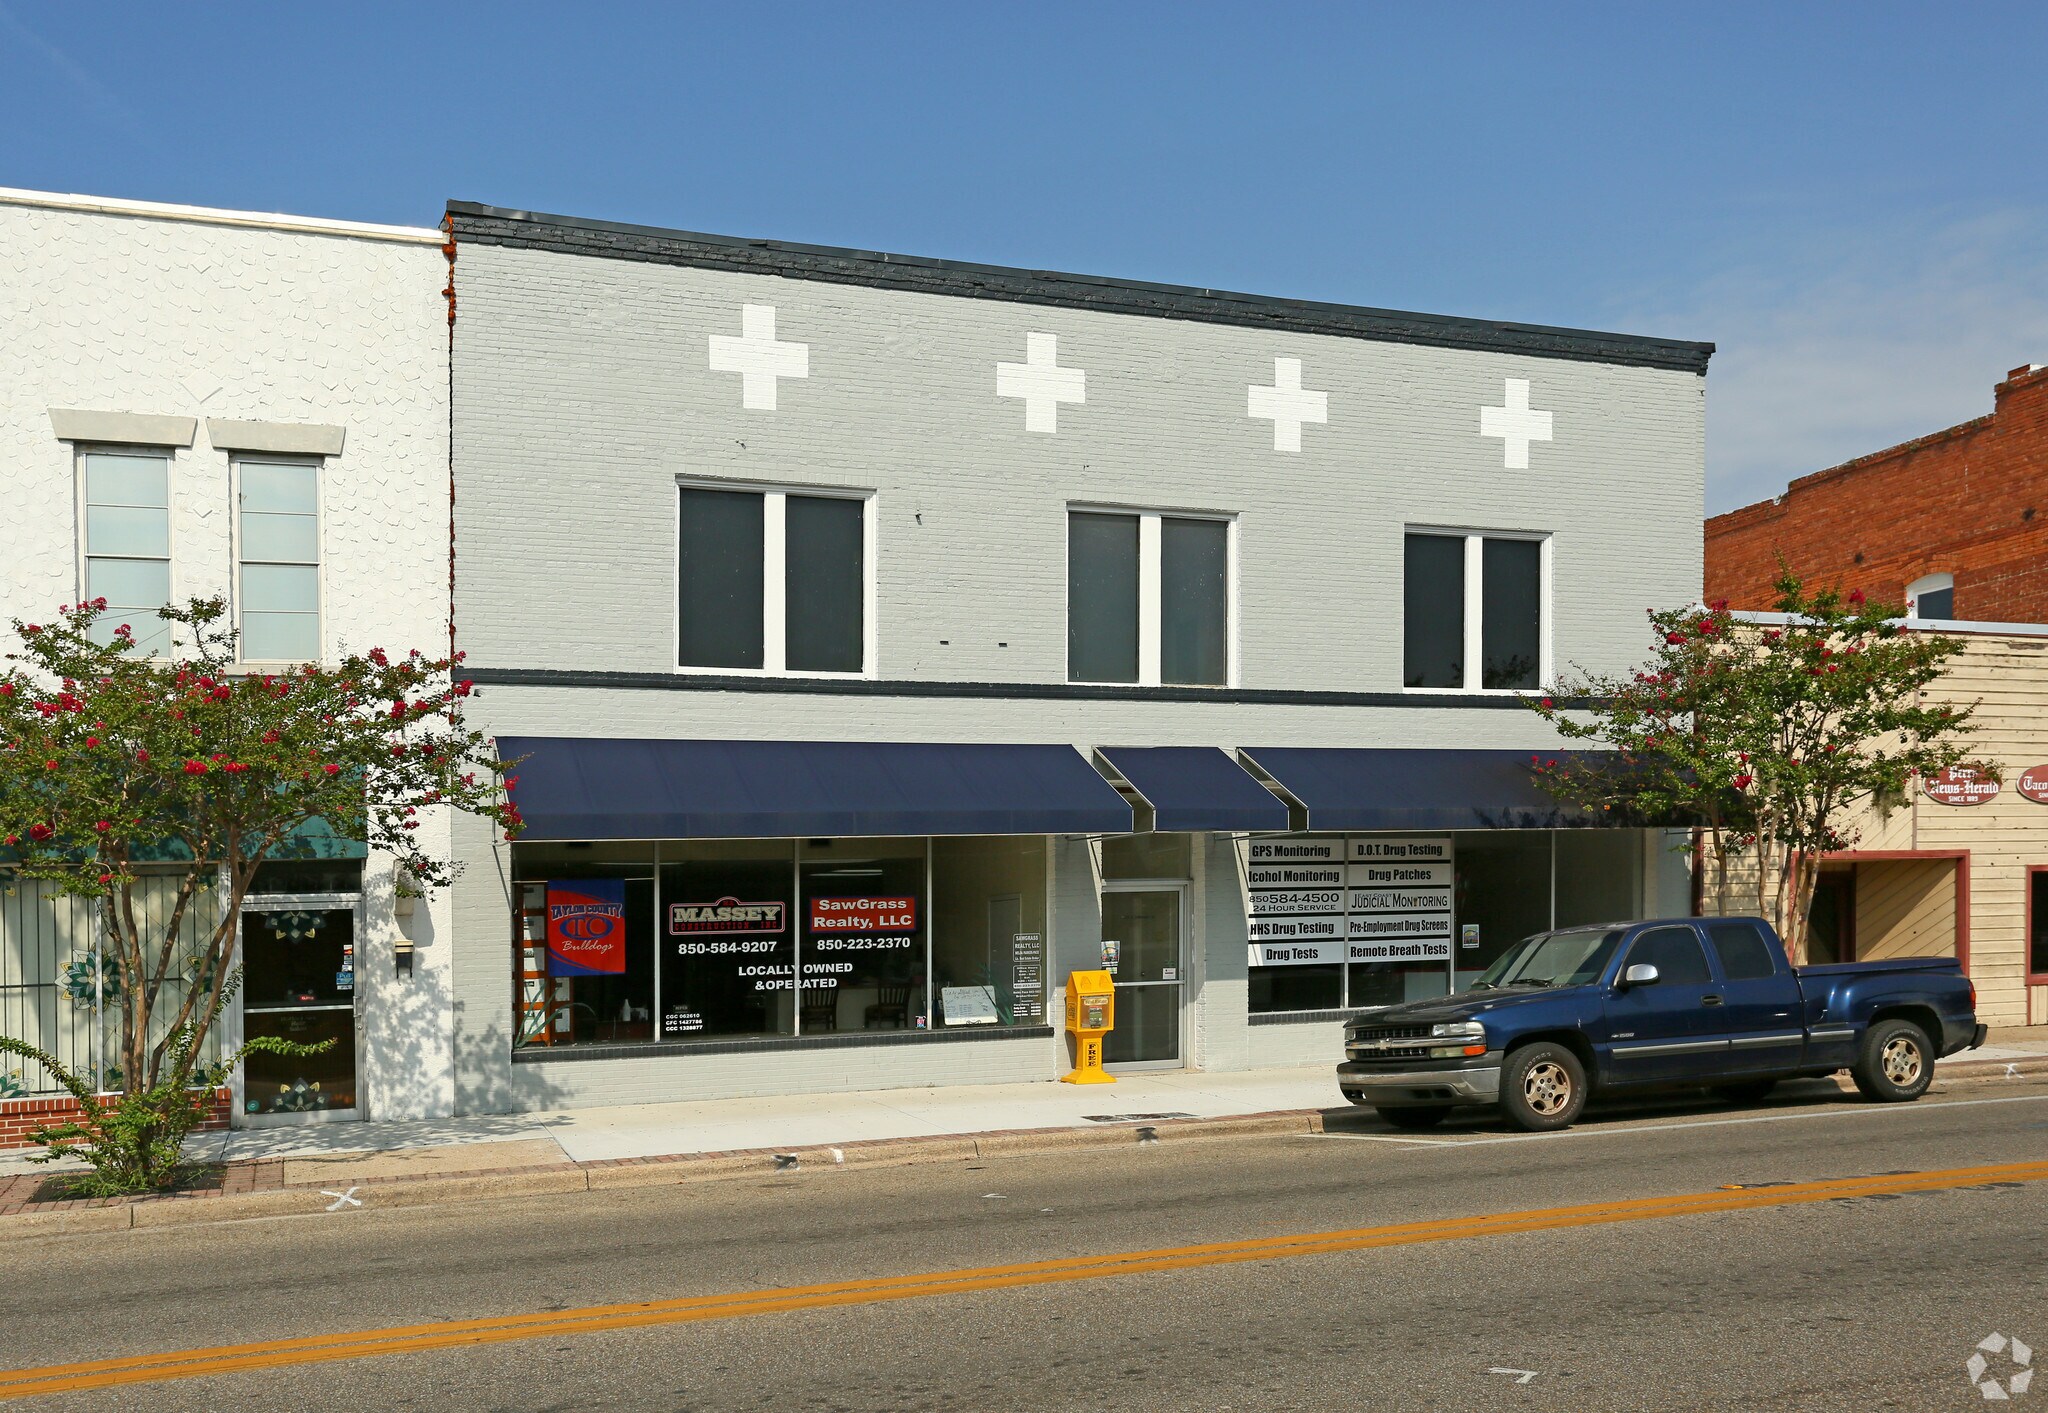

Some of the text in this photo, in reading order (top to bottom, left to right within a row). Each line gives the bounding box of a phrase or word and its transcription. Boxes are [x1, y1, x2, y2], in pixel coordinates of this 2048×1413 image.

[2023, 776, 2048, 790] Taco
[1252, 845, 1331, 857] GPS Monitoring
[1357, 844, 1443, 857] D.O.T. Drug Testing
[1249, 870, 1340, 882] lcohol Monitoring
[1368, 869, 1432, 881] Drug Patches
[818, 899, 907, 910] SawGrass
[1351, 894, 1390, 908] JUDICIAL
[551, 903, 622, 921] TAYLOR COUNTY
[674, 906, 780, 922] MASSEY
[813, 914, 912, 929] Realty, LLC
[1350, 920, 1448, 933] Pre-Employment Drug Screens
[1250, 922, 1334, 936] HHS Drug Testing
[562, 940, 614, 954] Bulldogs
[678, 942, 777, 954] 850-584-9207
[817, 937, 910, 950] 850-223-2370
[1266, 948, 1318, 961] Drug Tests
[1350, 944, 1448, 957] Remote Breath Tests
[803, 963, 853, 974] OWNED
[1088, 1044, 1096, 1067] FREE
